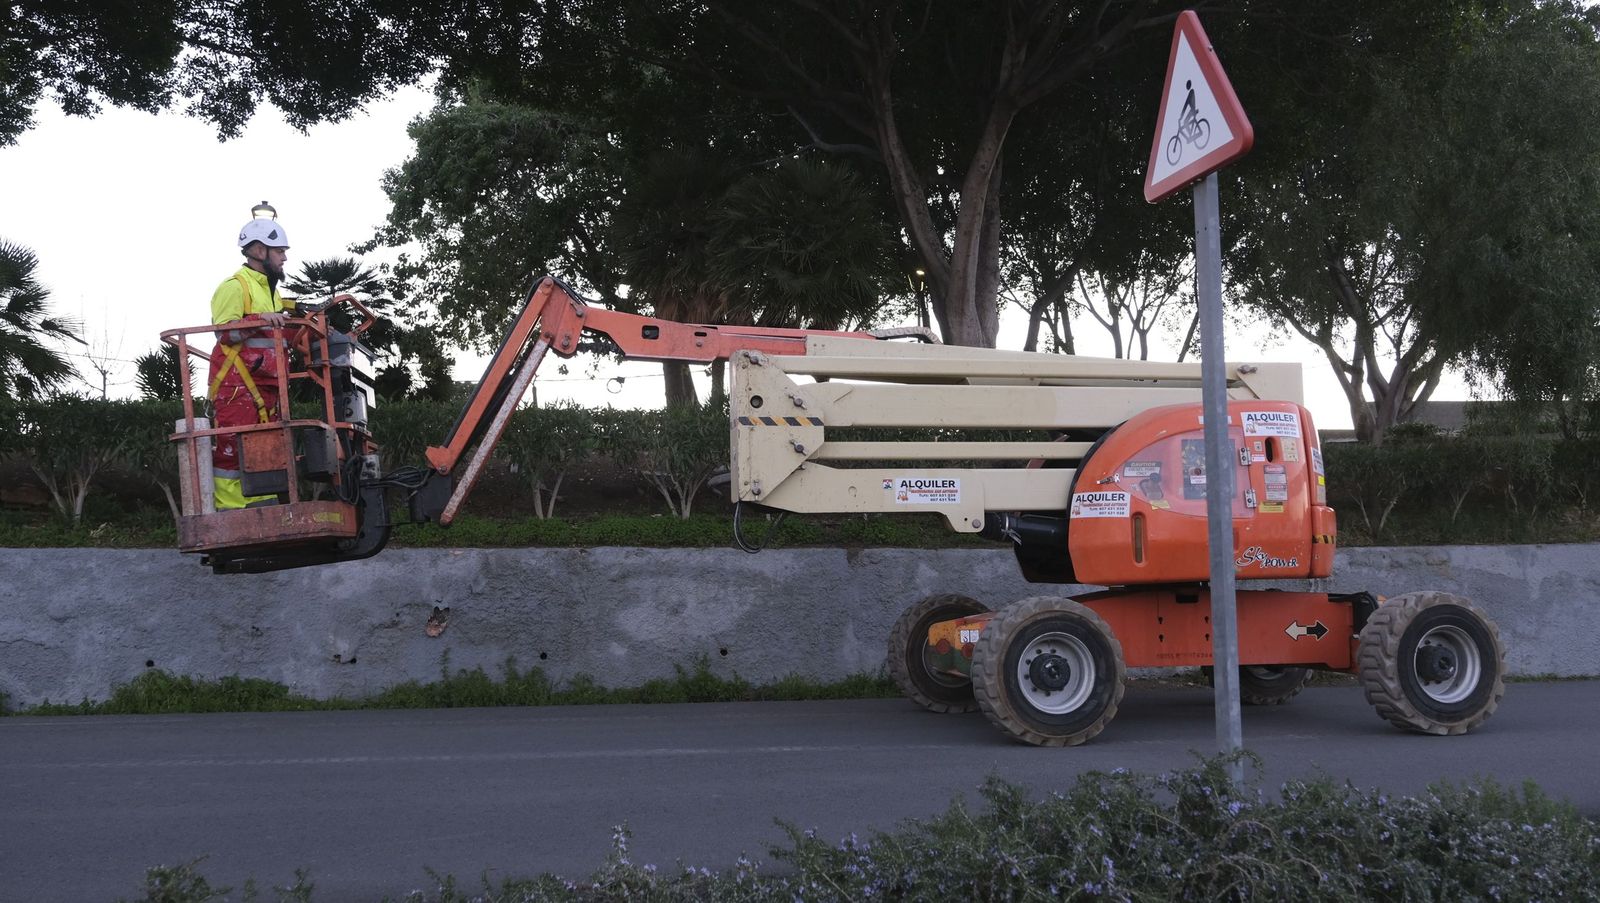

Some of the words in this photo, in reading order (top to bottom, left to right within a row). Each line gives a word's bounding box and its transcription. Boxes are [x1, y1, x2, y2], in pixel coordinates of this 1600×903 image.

[1247, 413, 1294, 422] ALQUILER
[900, 480, 955, 489] ALQUILER
[1076, 493, 1125, 503] ALQUILER
[1236, 546, 1267, 567] Sky
